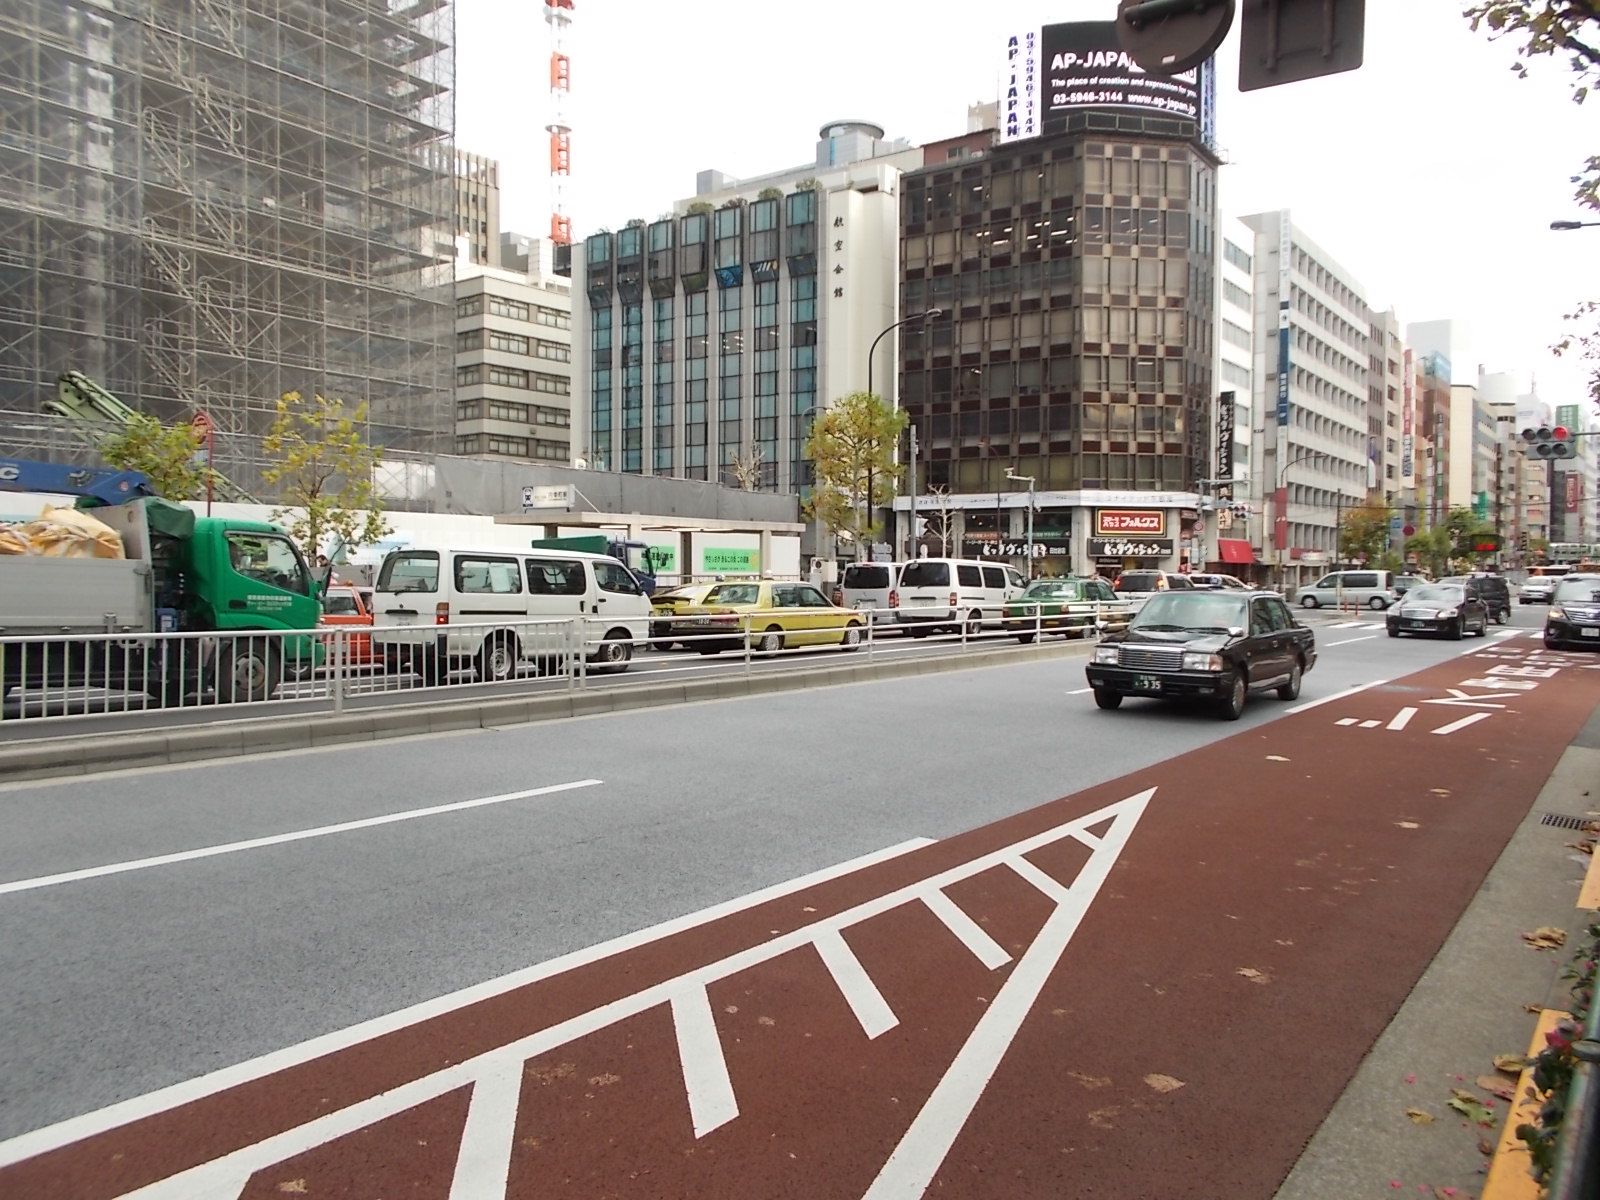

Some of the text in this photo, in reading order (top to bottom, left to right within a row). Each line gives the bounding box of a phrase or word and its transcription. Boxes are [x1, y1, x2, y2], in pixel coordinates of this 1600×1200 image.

[1051, 51, 1132, 71] AP-JAPA
[1051, 78, 1066, 87] The
[1067, 77, 1088, 88] place
[1089, 76, 1098, 85] of
[1099, 77, 1129, 86] creation
[1130, 77, 1144, 86] and
[1145, 80, 1178, 92] expression
[1178, 85, 1187, 93] for
[1053, 91, 1196, 115] 03-5946-3144 www.ap-japan.jp
